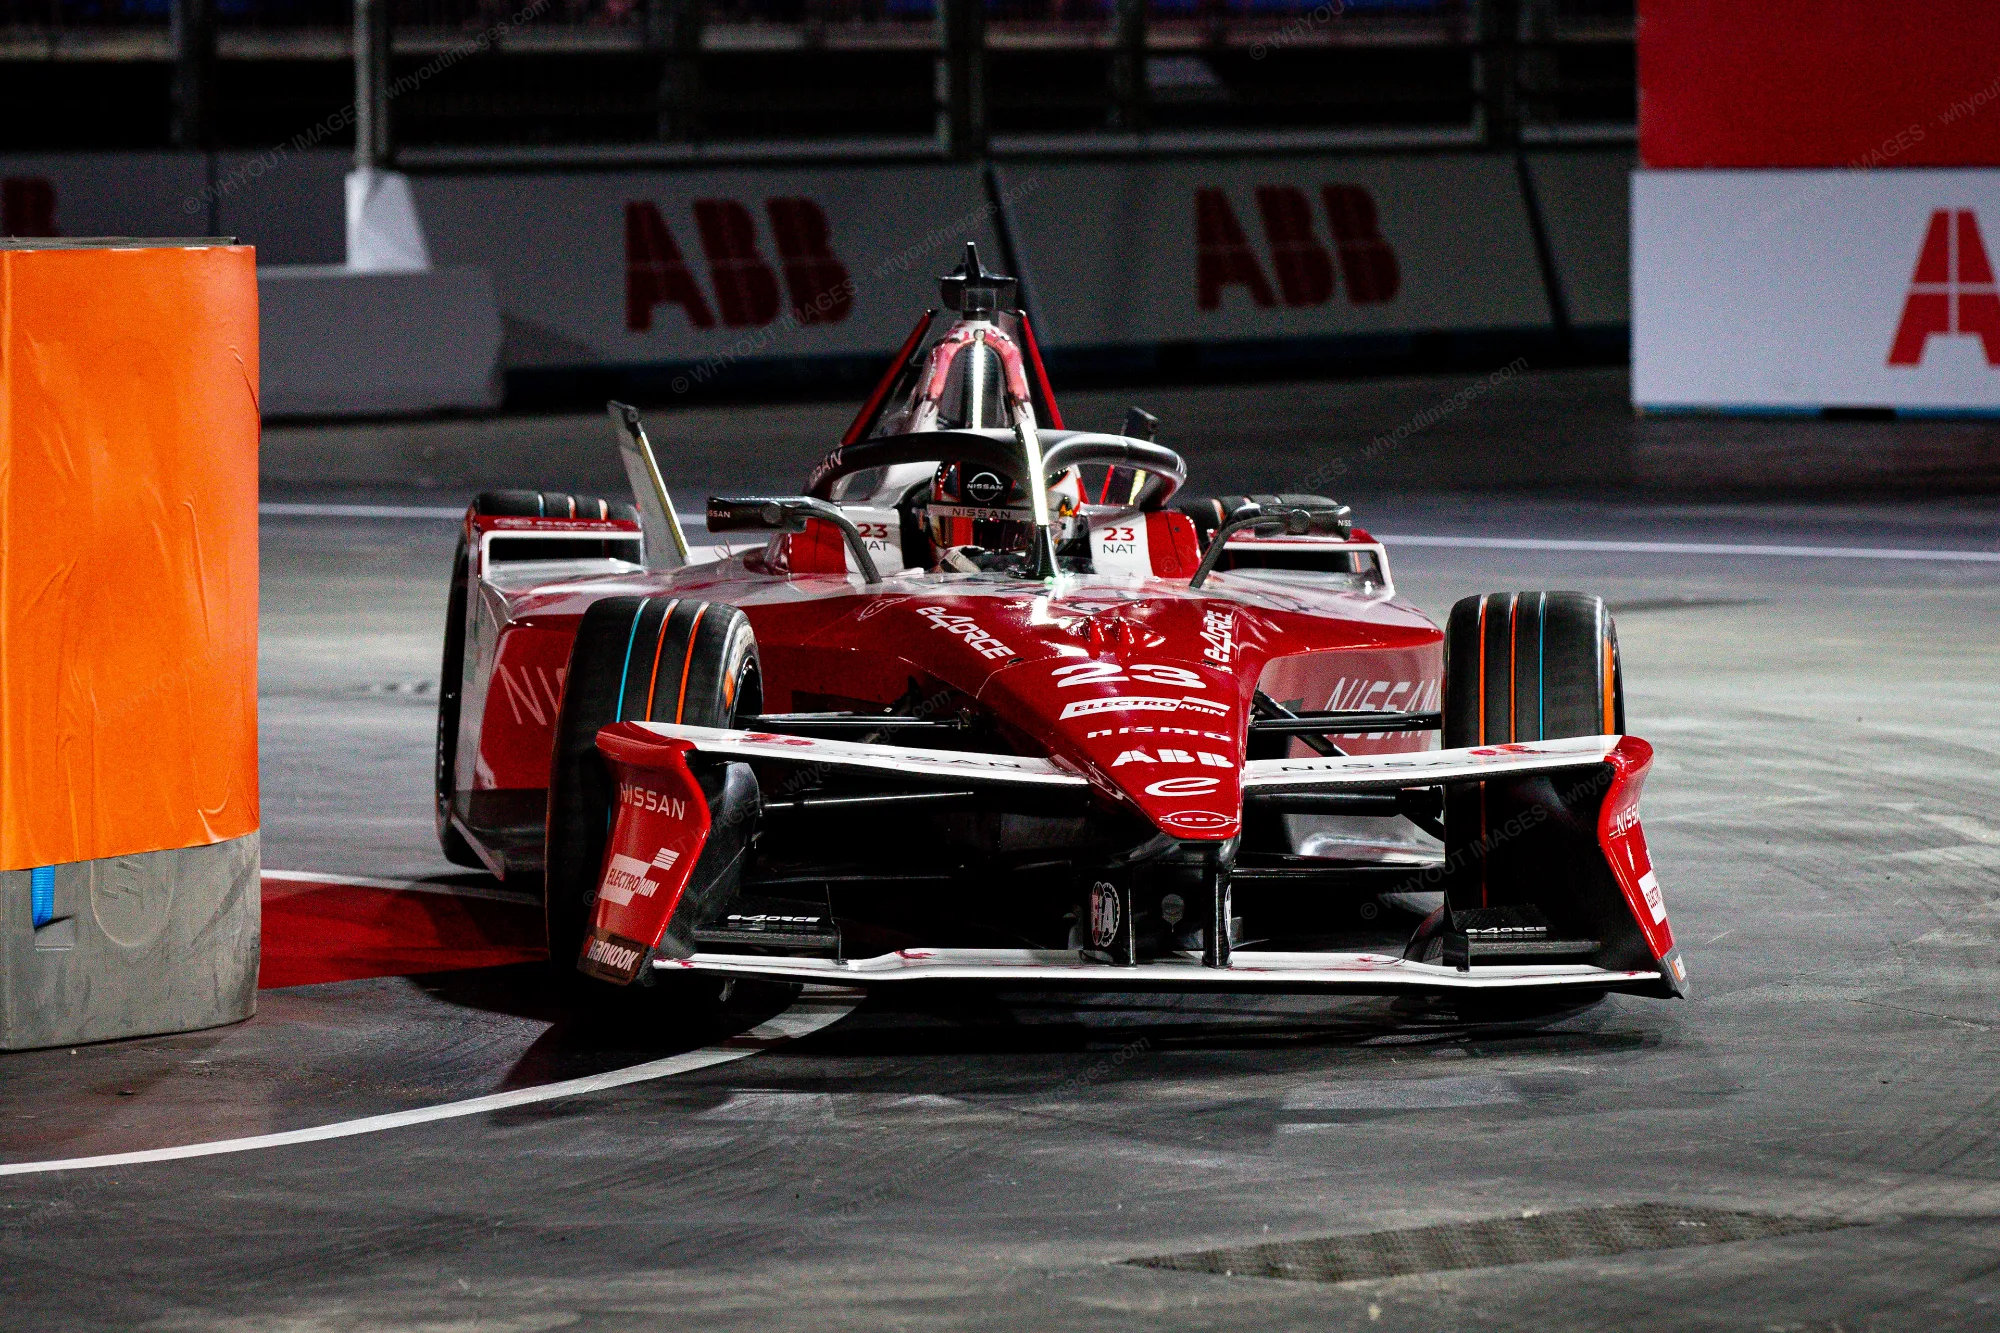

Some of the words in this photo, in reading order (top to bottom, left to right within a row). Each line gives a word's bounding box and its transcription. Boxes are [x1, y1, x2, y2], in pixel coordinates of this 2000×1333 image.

[1196, 184, 1397, 308] ABB
[627, 197, 852, 328] ABB
[967, 483, 1004, 491] NISSAN
[951, 507, 1012, 519] NISSAN
[857, 523, 888, 539] 23
[1103, 527, 1135, 541] 23
[1103, 544, 1137, 554] NAT
[1051, 662, 1207, 689] 23
[1086, 726, 1233, 742] nismo
[1111, 748, 1235, 768] ABB
[619, 782, 685, 821] NISSAN
